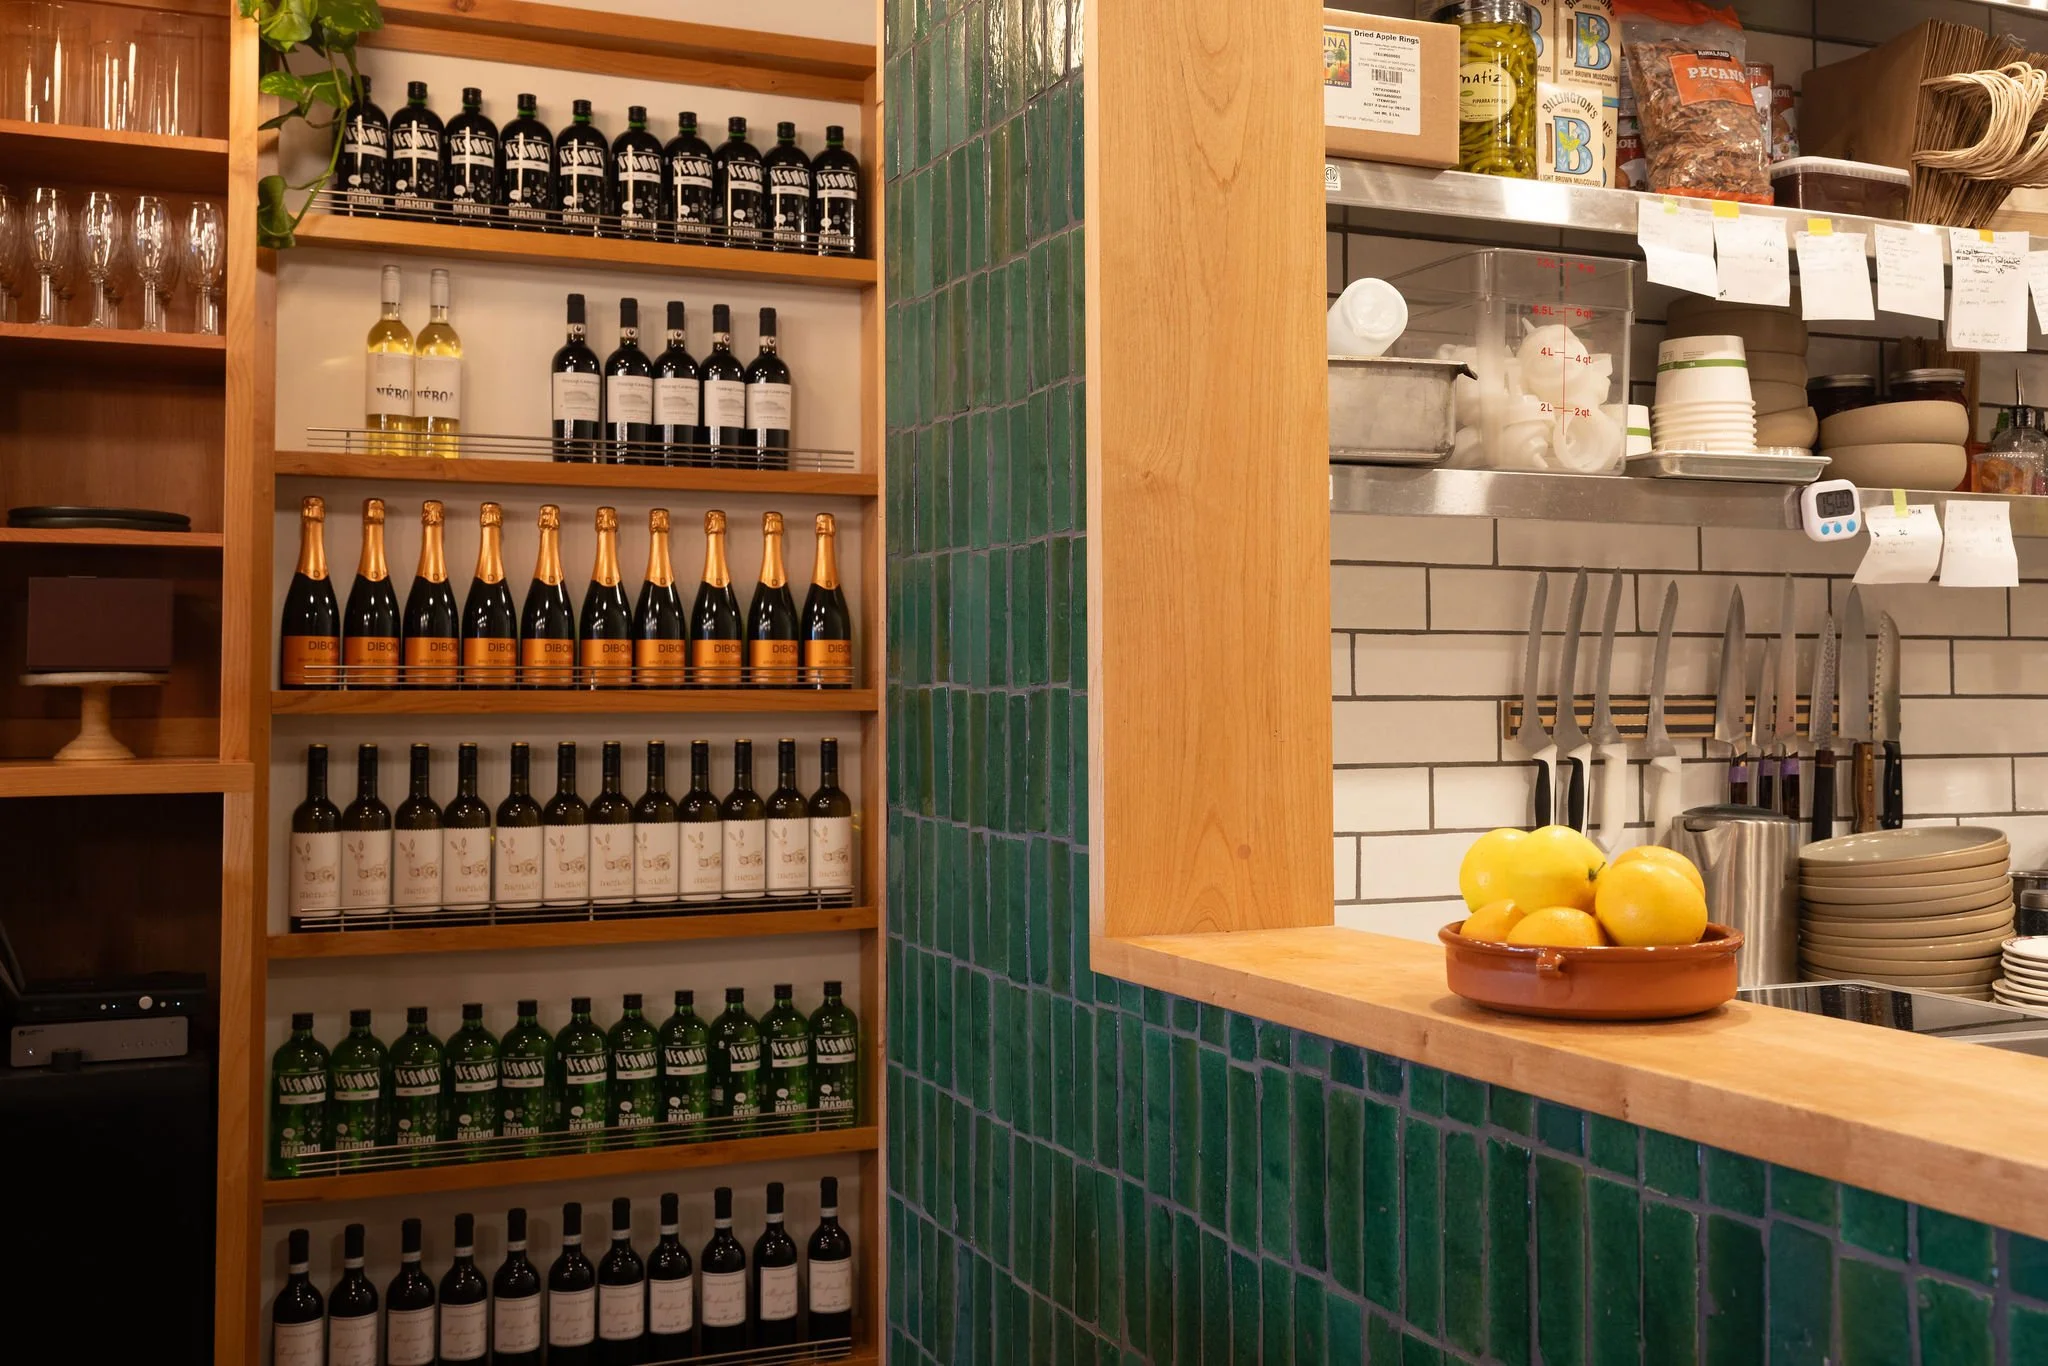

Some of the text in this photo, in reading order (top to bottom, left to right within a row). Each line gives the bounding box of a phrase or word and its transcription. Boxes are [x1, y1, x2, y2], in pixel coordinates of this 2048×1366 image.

[1354, 30, 1419, 45] Dried Apple Rings
[1687, 66, 1746, 85] PECANS
[1542, 92, 1598, 119] BILLINGTON'S
[615, 1050, 657, 1068] VERMUT
[664, 1048, 708, 1065] VERMUT
[394, 1067, 440, 1086] VERMUT
[454, 1062, 498, 1080] VERMUT
[502, 1060, 545, 1077] VERMUT
[279, 1074, 327, 1094] VERMUT
[334, 1071, 380, 1089] VERMUT
